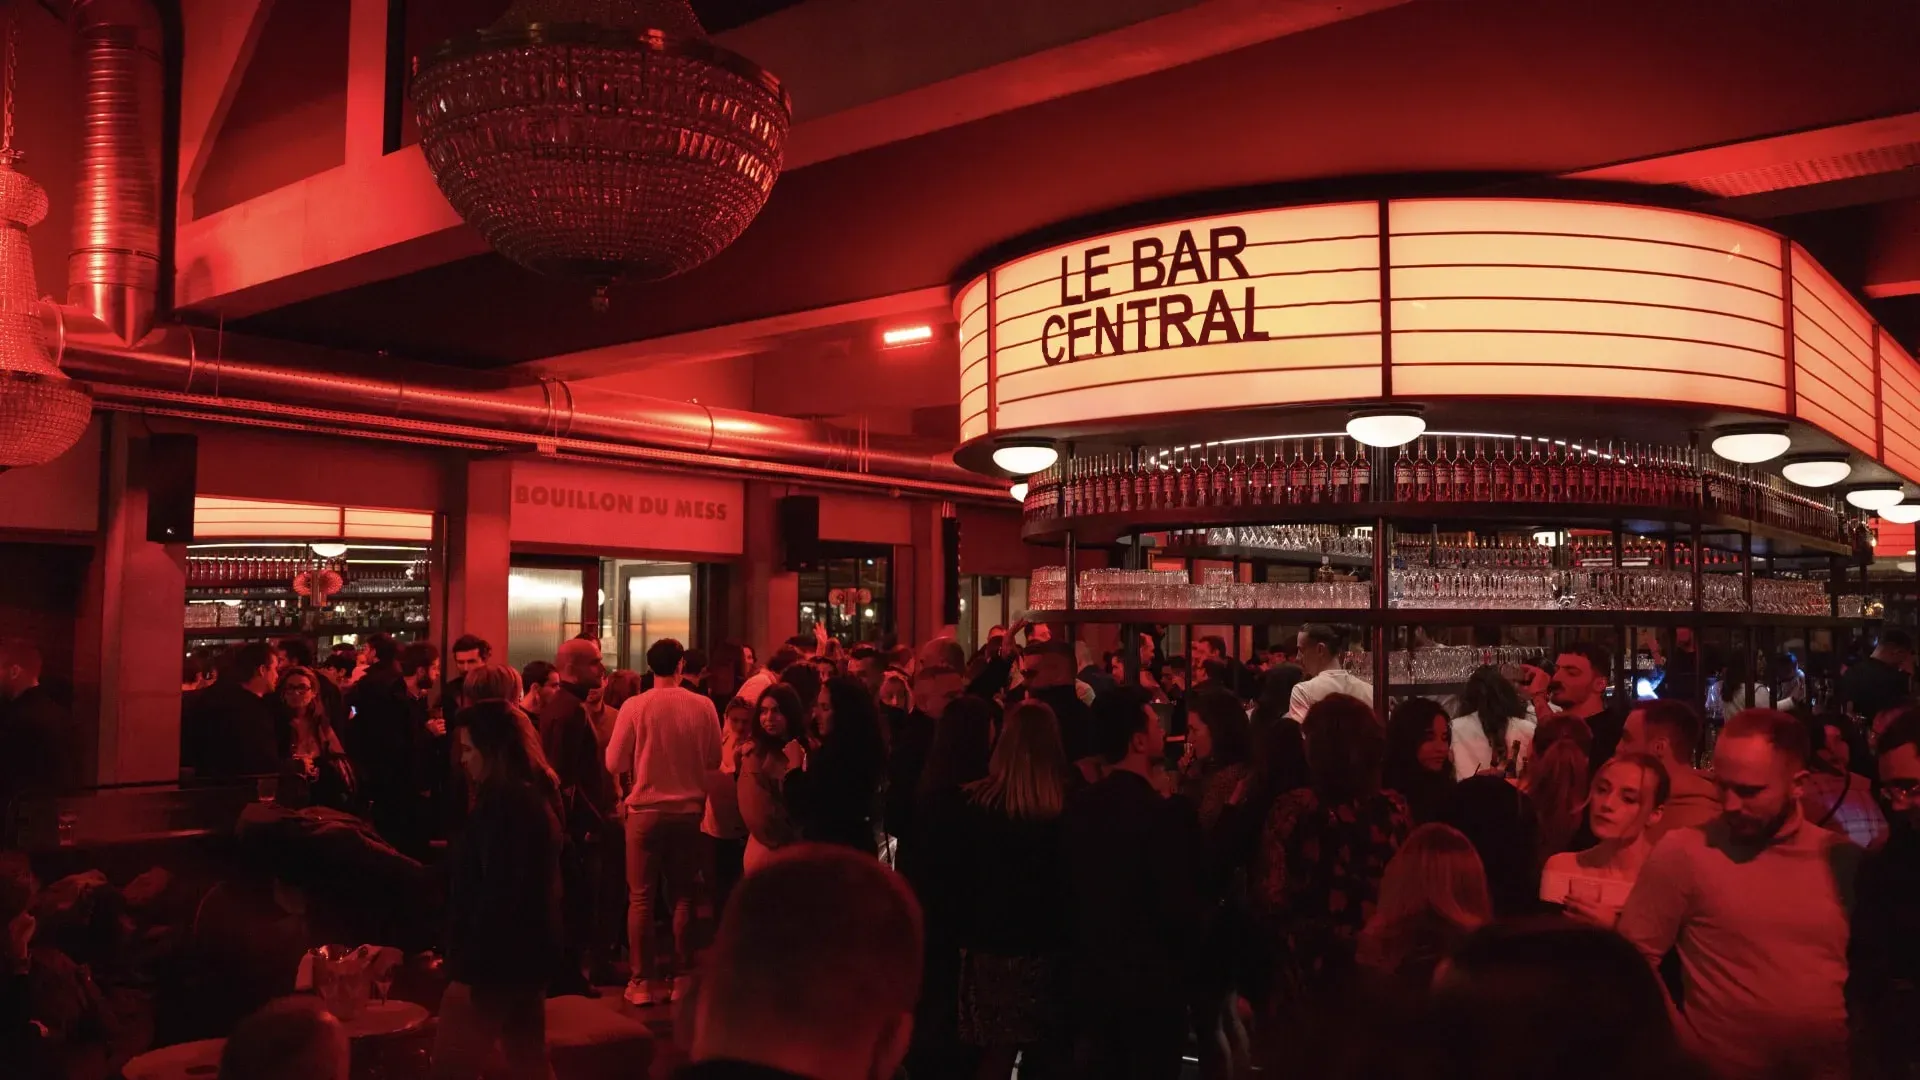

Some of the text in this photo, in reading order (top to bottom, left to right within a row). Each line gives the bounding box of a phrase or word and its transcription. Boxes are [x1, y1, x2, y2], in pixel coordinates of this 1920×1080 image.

[1061, 226, 1250, 306] LE BAR
[1041, 286, 1270, 367] CENTRAL
[514, 485, 727, 521] BOUILLON DU MESS
